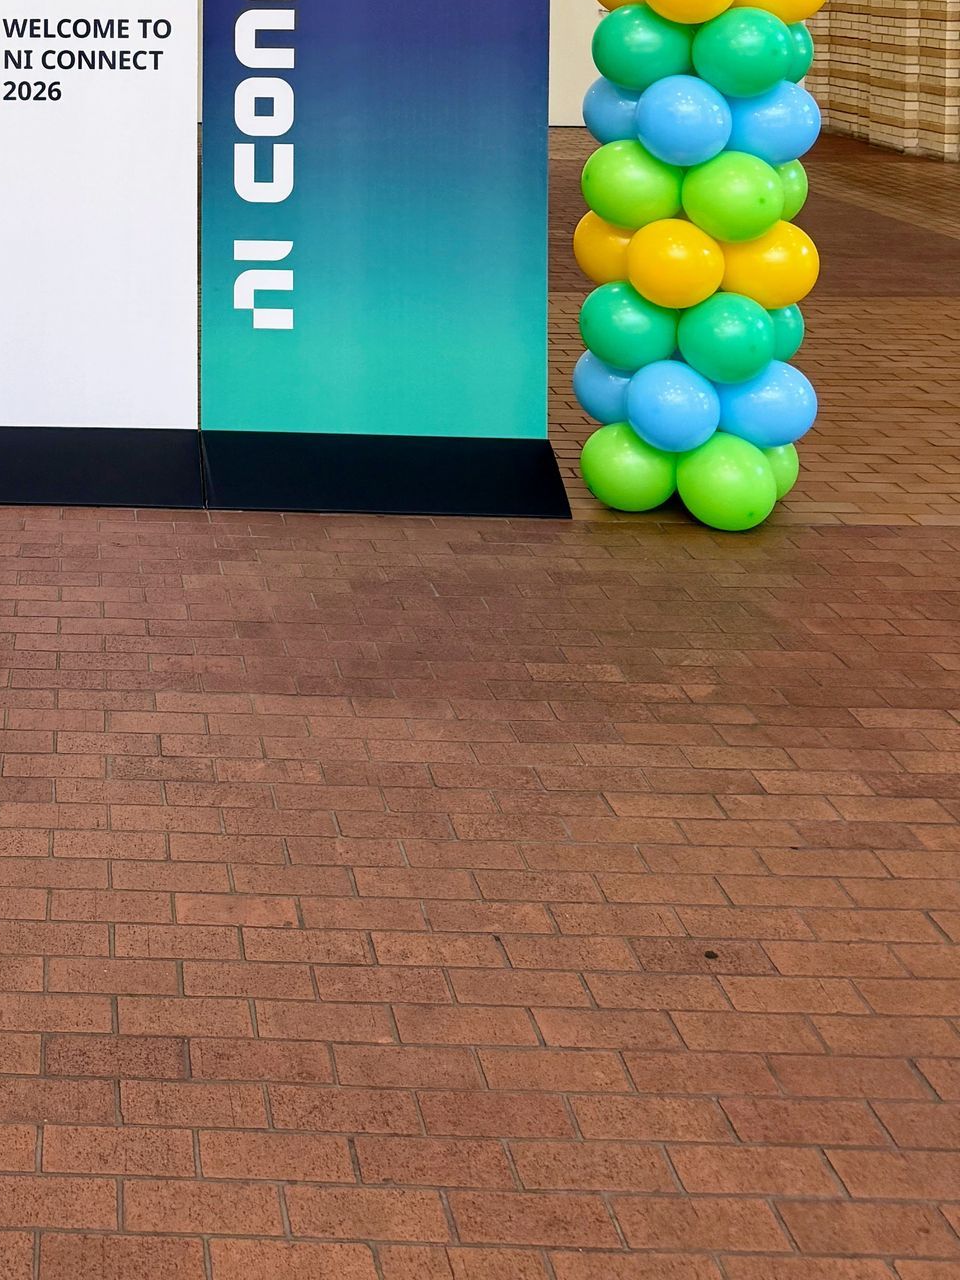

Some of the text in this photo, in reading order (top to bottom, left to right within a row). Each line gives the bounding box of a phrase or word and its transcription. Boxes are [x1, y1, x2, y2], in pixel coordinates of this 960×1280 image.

[2, 18, 172, 40] WELCOME TO
[4, 49, 164, 71] NI CONNECT
[2, 80, 62, 102] 2026
